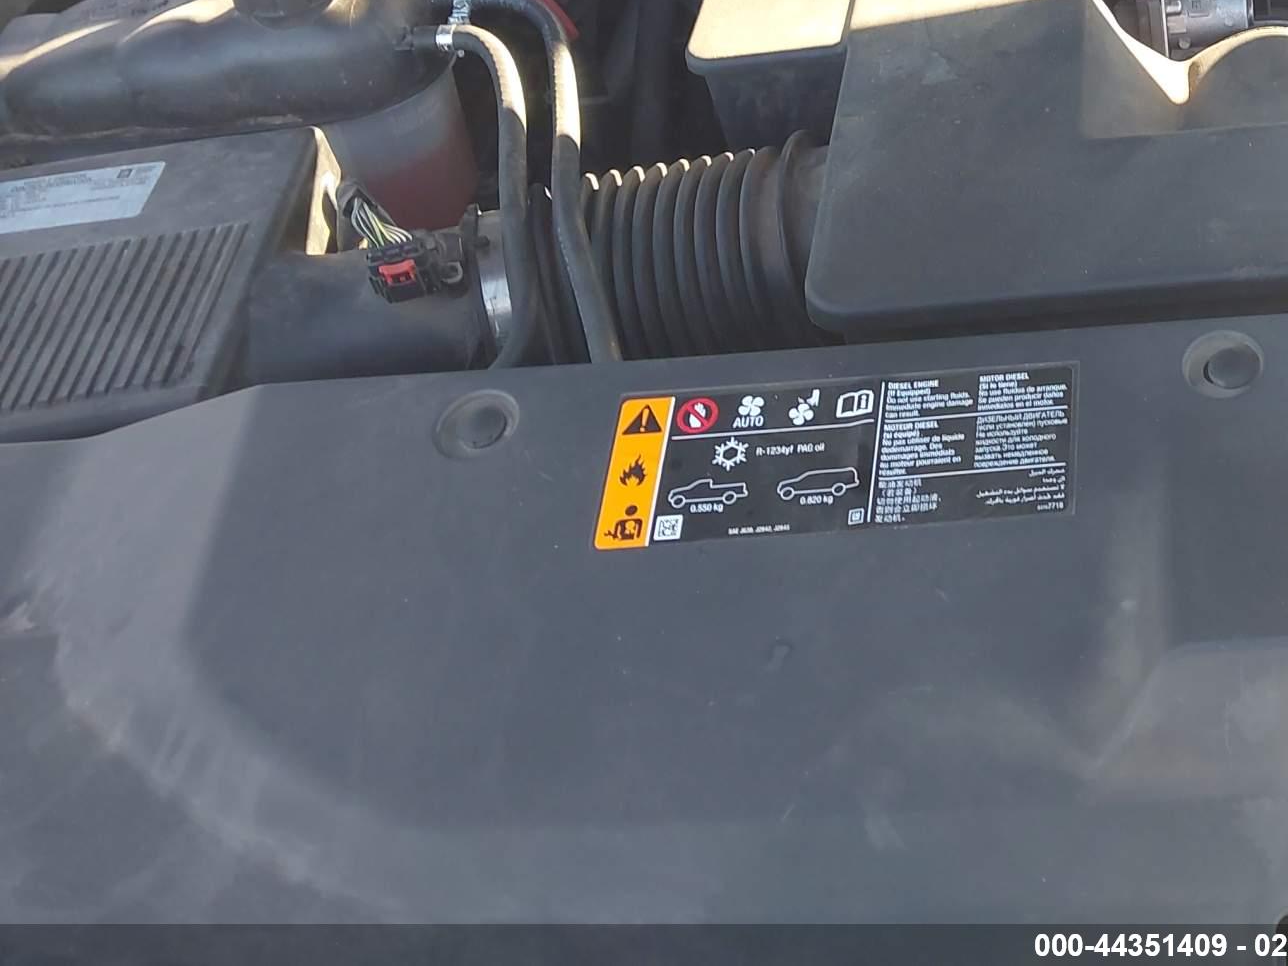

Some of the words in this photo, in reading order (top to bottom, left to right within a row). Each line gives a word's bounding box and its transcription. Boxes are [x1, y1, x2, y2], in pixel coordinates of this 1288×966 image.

[979, 374, 1004, 383] MOTOR
[1005, 372, 1029, 381] DIESEL
[887, 381, 912, 390] DIESEL
[732, 415, 764, 429] AUTO
[884, 422, 914, 431] MOTEUR
[914, 420, 939, 429] DIESEL
[823, 495, 833, 505] kg
[713, 502, 723, 512] kg
